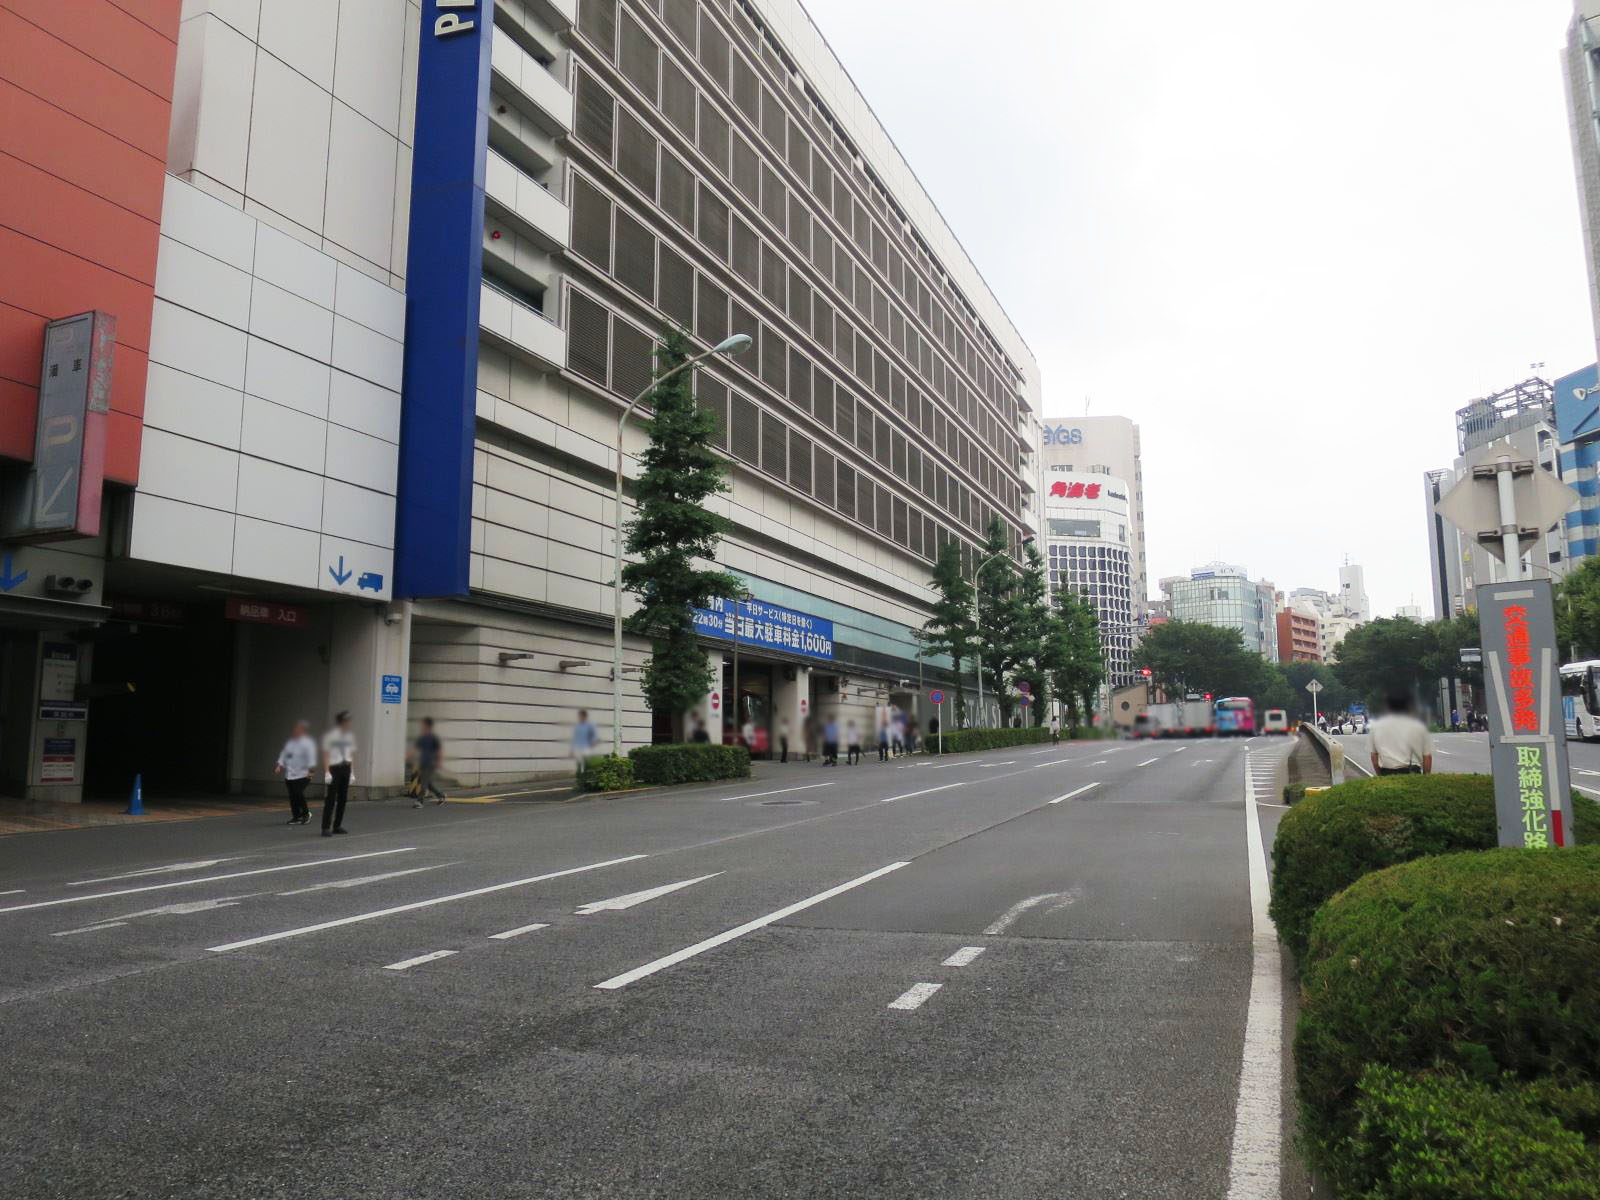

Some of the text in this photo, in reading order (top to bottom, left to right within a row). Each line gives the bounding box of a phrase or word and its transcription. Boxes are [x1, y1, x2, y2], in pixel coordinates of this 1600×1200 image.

[434, 0, 476, 37] P
[277, 608, 297, 622] 入口
[1503, 603, 1538, 731] 交通事故多発
[1516, 746, 1550, 849] 取締強化路
